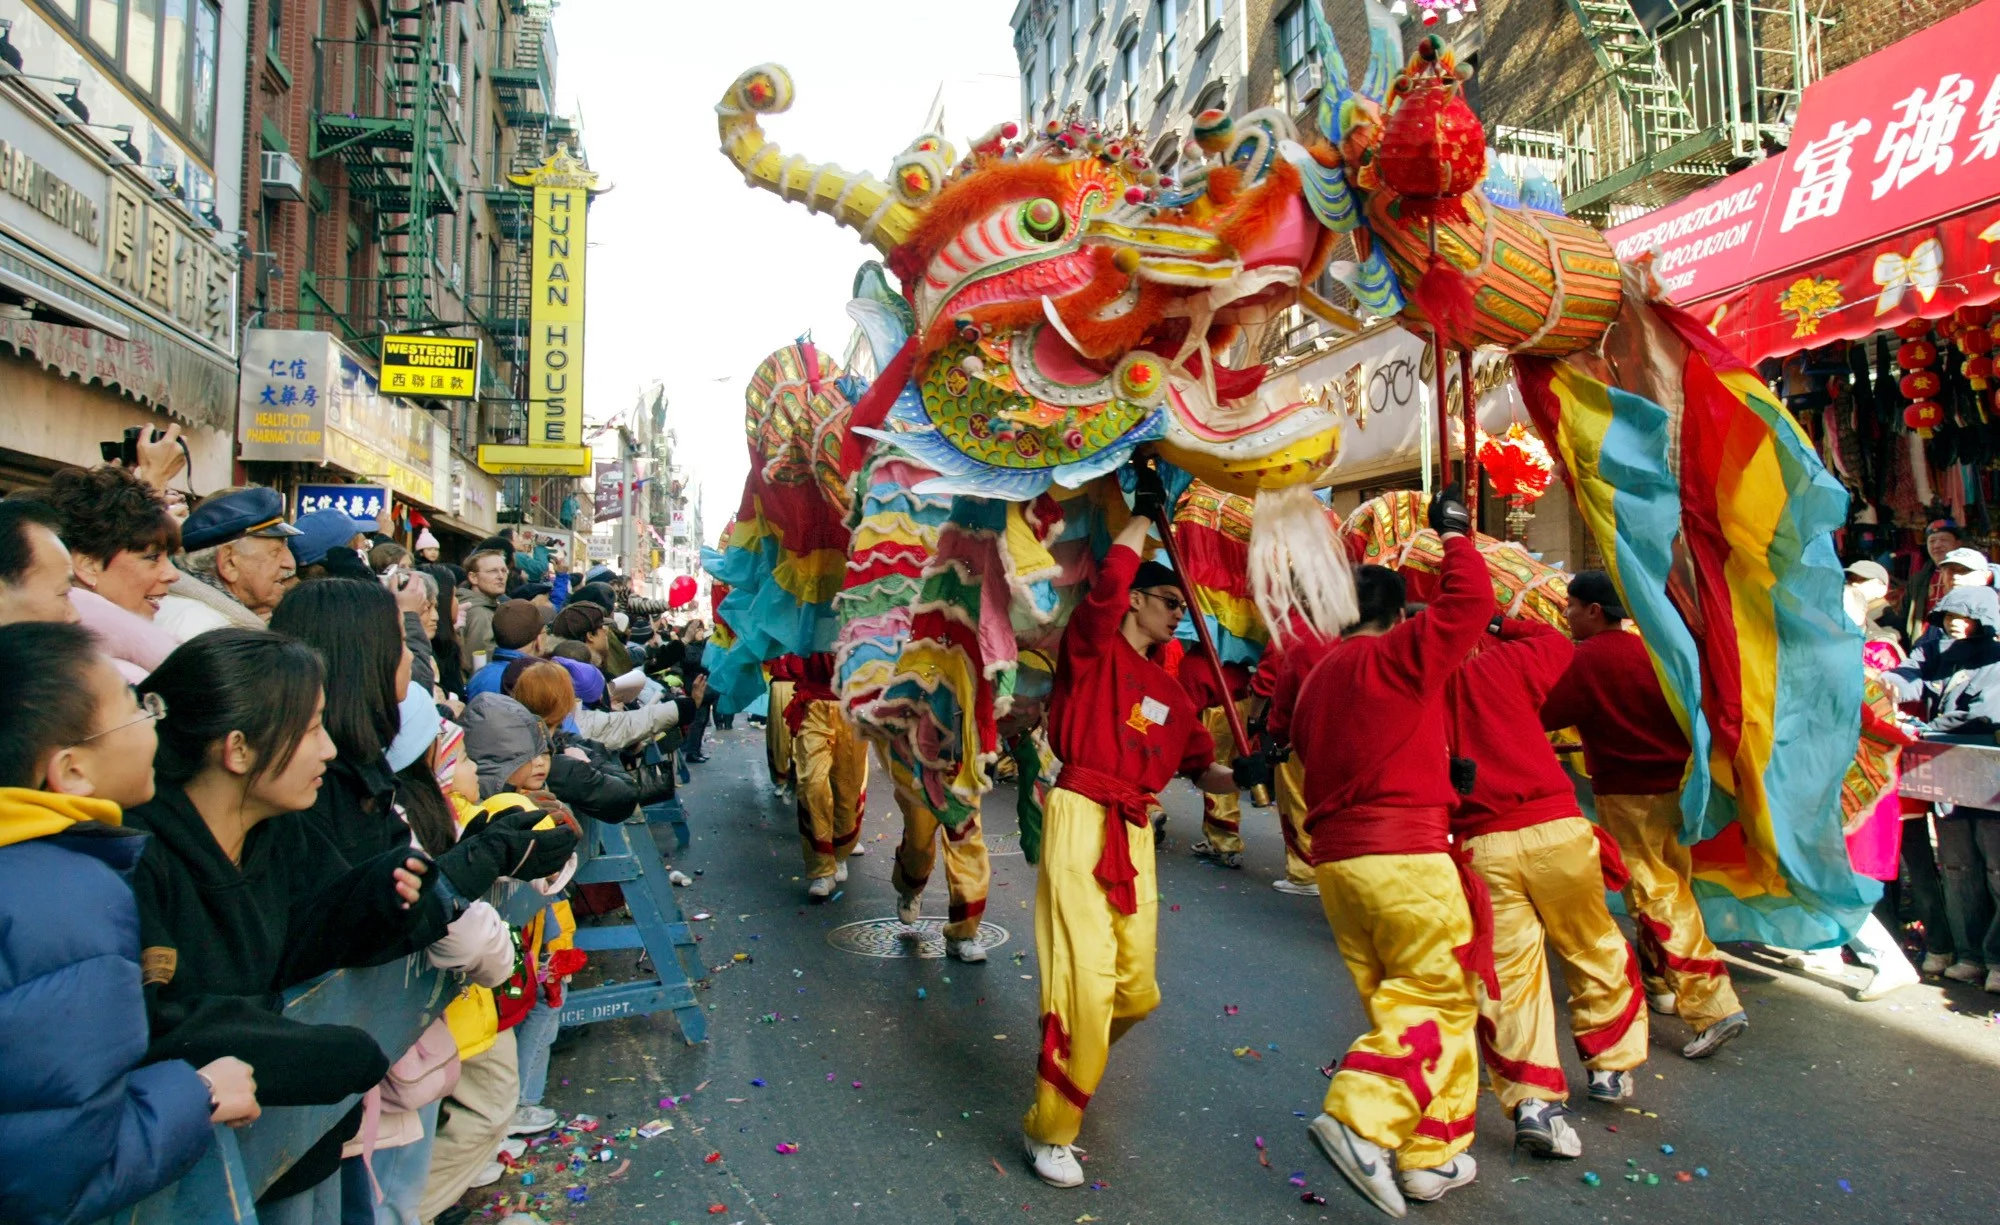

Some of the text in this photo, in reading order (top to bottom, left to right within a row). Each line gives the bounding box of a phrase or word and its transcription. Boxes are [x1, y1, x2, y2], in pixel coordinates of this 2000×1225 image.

[10, 147, 75, 229] BAKERY
[1616, 182, 1764, 260] INTERNATIONAL
[547, 192, 571, 307] HUNAN
[1660, 220, 1753, 273] RPORATION
[386, 342, 457, 357] WESTERN
[408, 354, 456, 367] UNION
[267, 358, 308, 380] 仁信
[392, 373, 464, 390] 西聯匯款
[544, 326, 568, 442] HOUSE
[259, 384, 320, 407] 大藥房
[256, 412, 311, 428] HEALTH CITY
[246, 427, 295, 444] PHARMACY
[562, 1001, 634, 1023] ICE DEPT.
